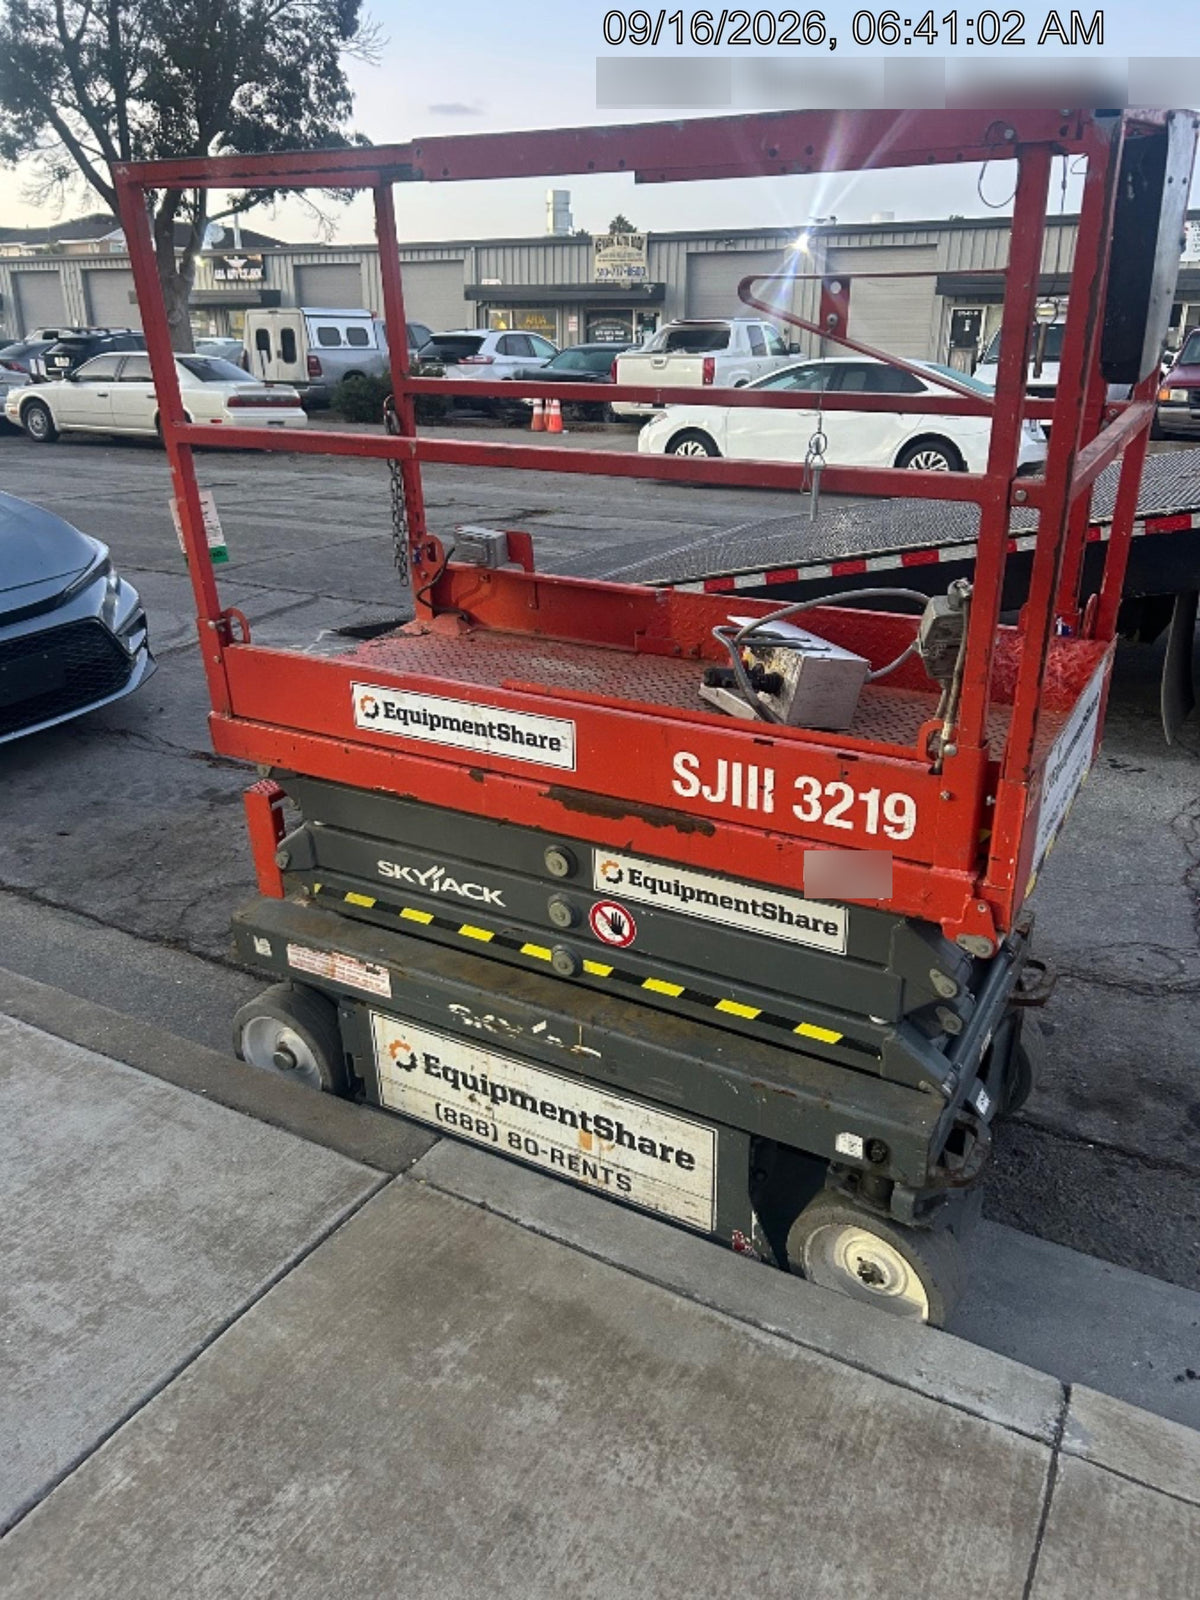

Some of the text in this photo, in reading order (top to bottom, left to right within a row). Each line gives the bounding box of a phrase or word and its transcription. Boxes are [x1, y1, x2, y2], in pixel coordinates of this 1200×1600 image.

[383, 700, 562, 752] EquipmentShare
[792, 775, 917, 840] 3219
[377, 859, 507, 908] SKYJACK
[628, 867, 839, 936] EquipmentShare
[422, 1052, 696, 1171] EquipmentShare
[434, 1103, 632, 1193] (888) 80-RENTS
